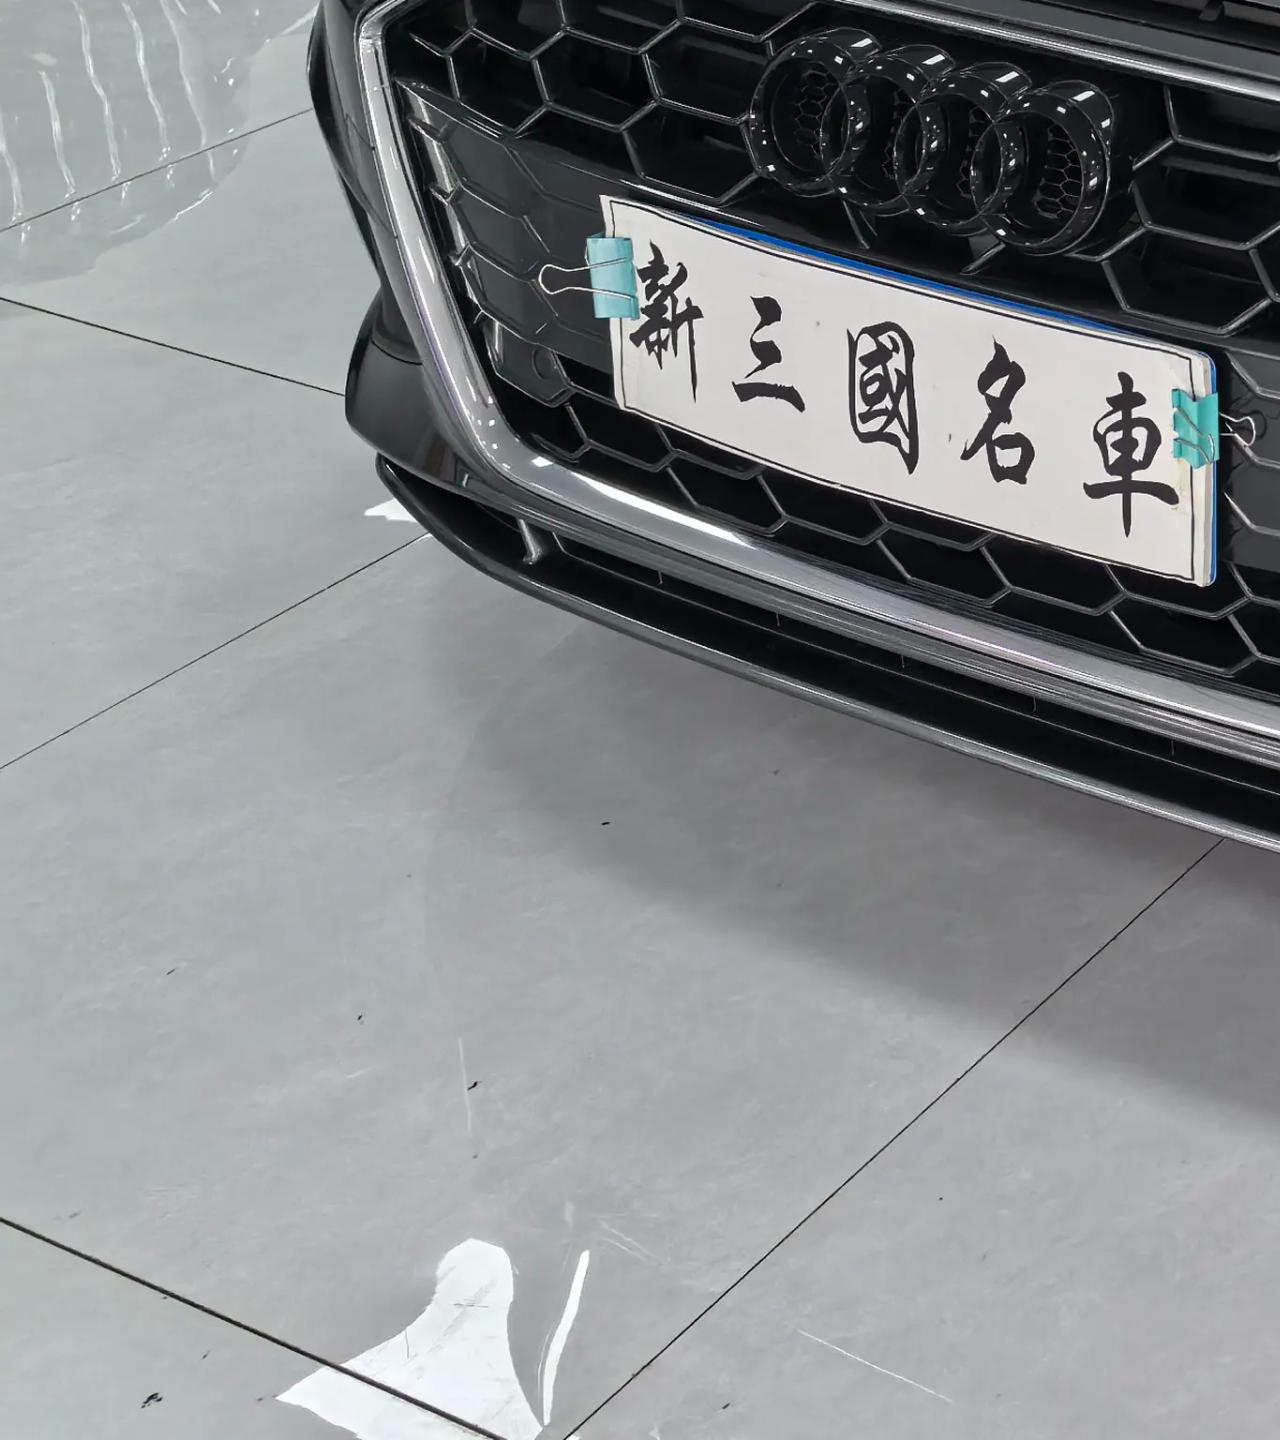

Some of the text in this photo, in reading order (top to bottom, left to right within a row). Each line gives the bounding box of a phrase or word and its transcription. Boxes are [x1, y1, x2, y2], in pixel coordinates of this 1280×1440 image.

[629, 240, 1180, 538] 新三國名車
